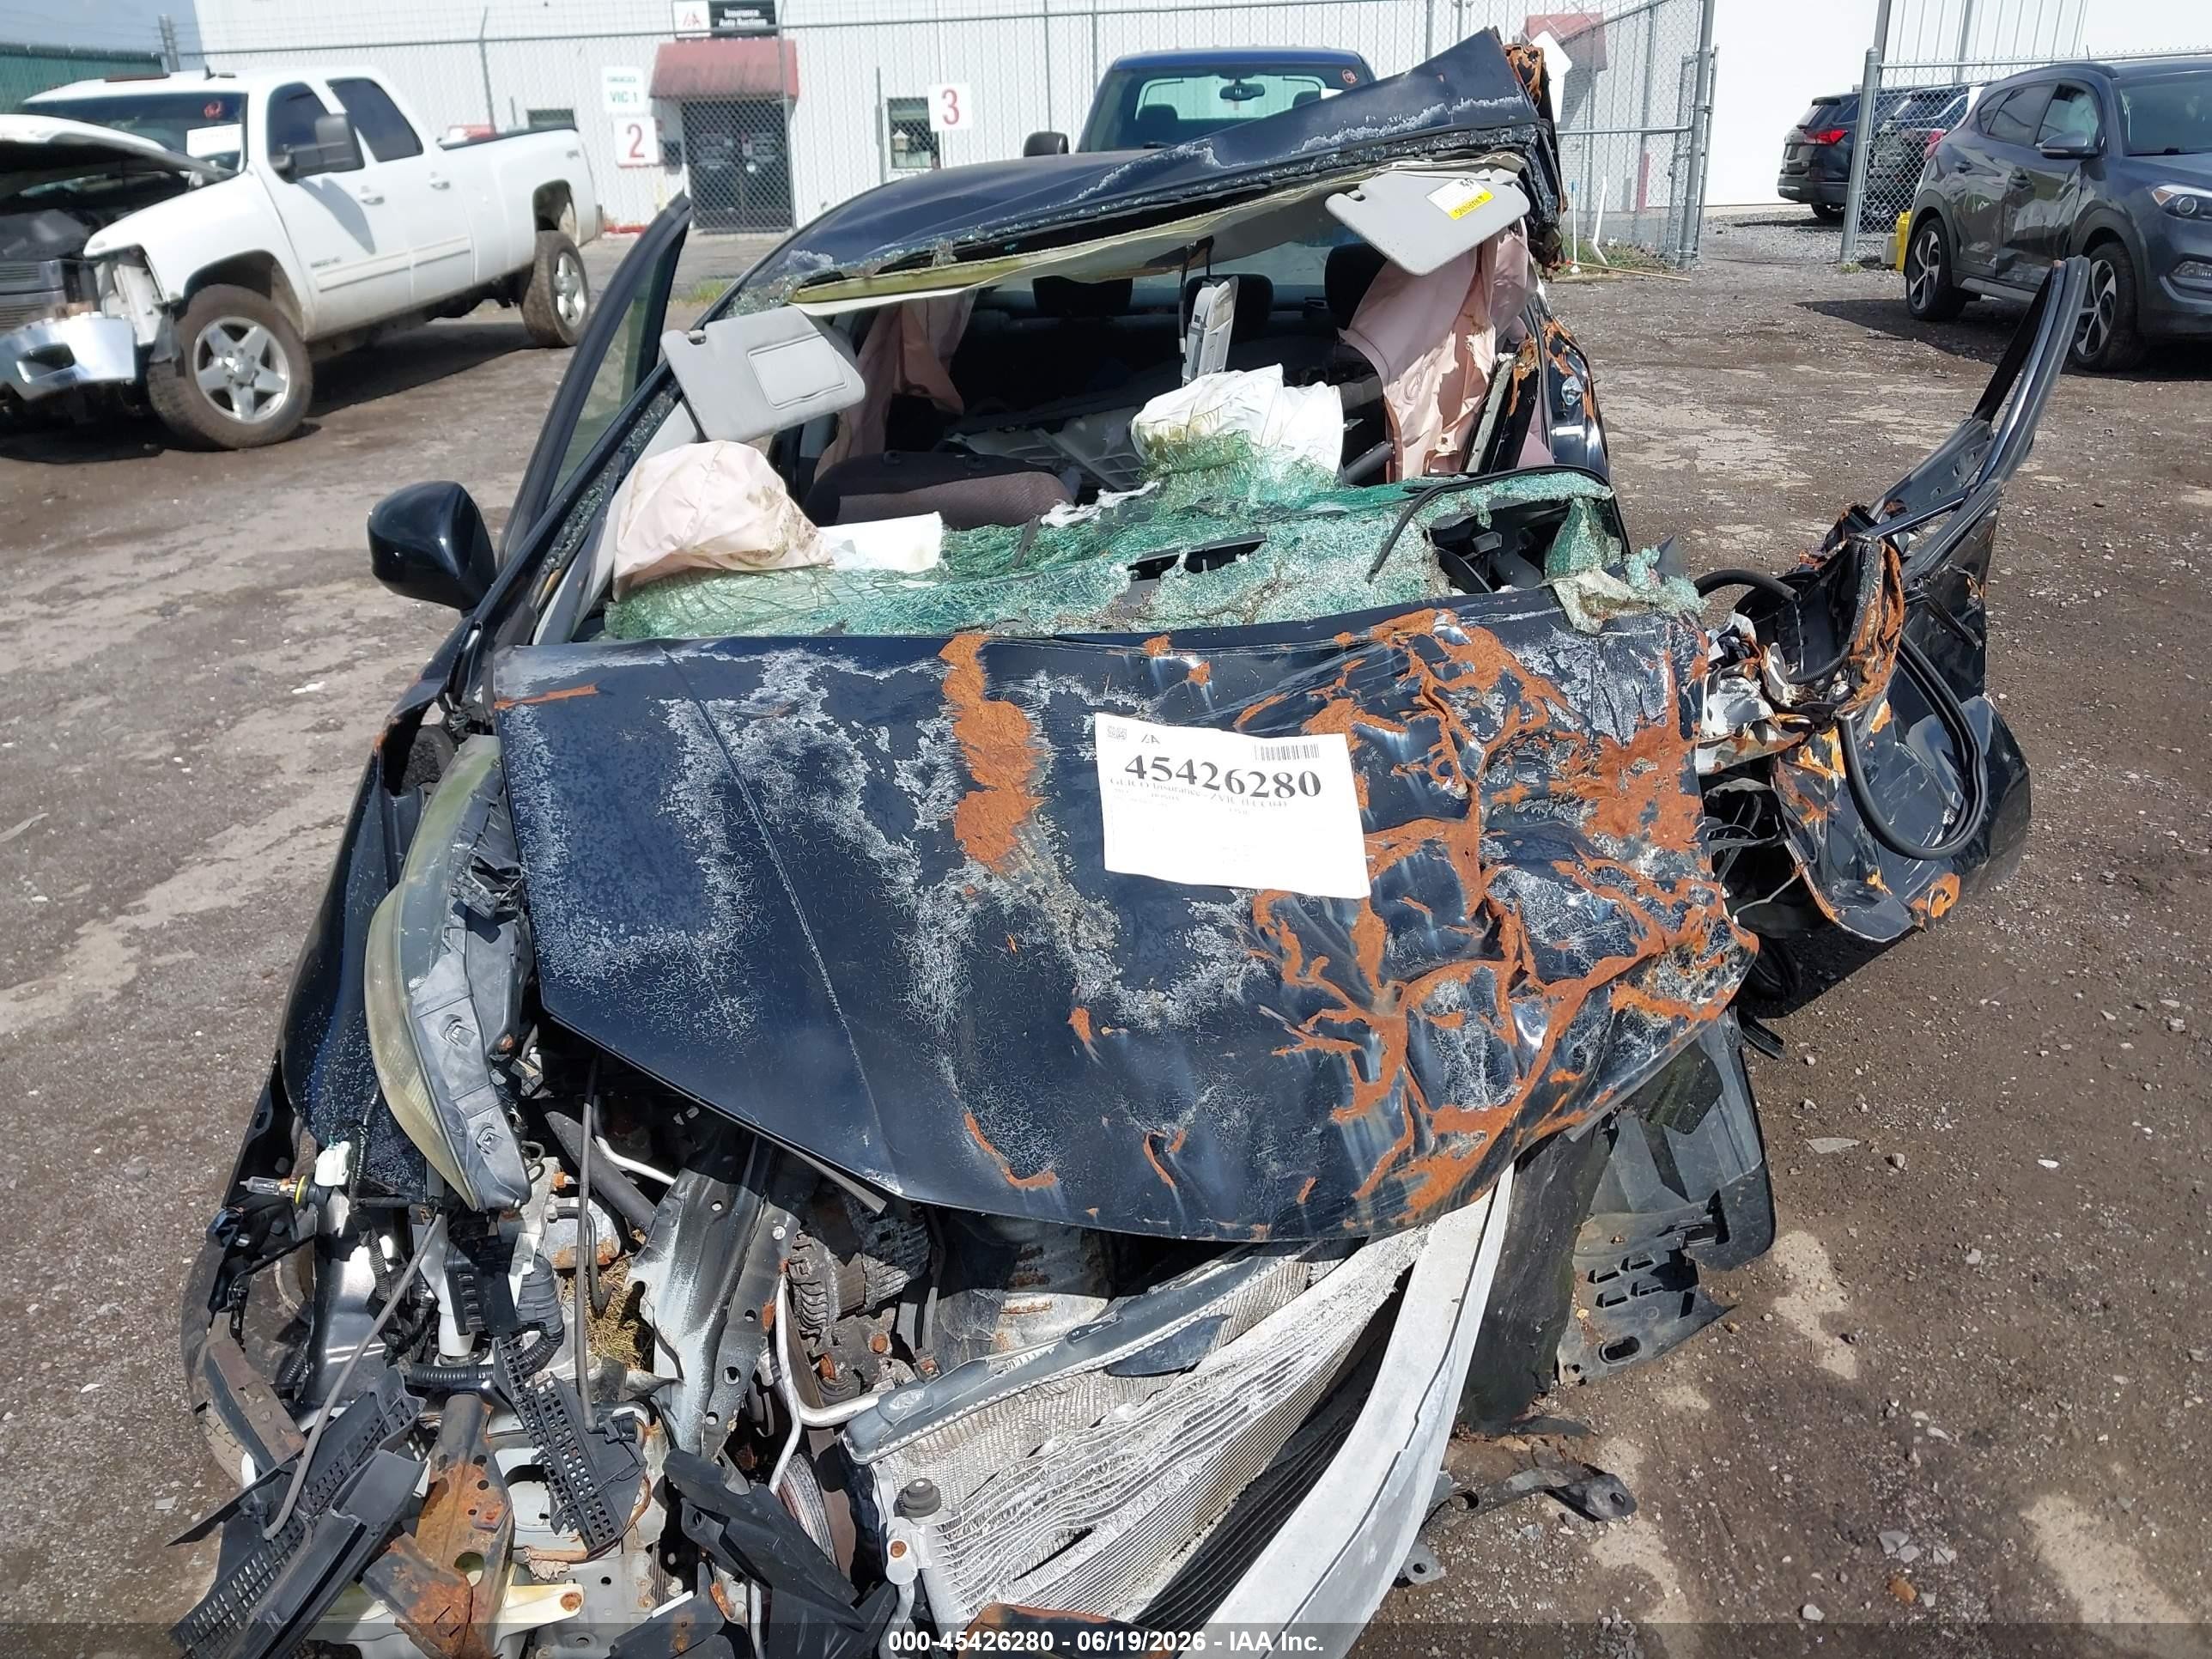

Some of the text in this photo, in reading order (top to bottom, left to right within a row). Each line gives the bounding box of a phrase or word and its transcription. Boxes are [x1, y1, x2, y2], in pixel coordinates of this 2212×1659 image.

[941, 88, 959, 125] 3
[627, 123, 646, 158] 2
[1125, 754, 1322, 799] 45426280
